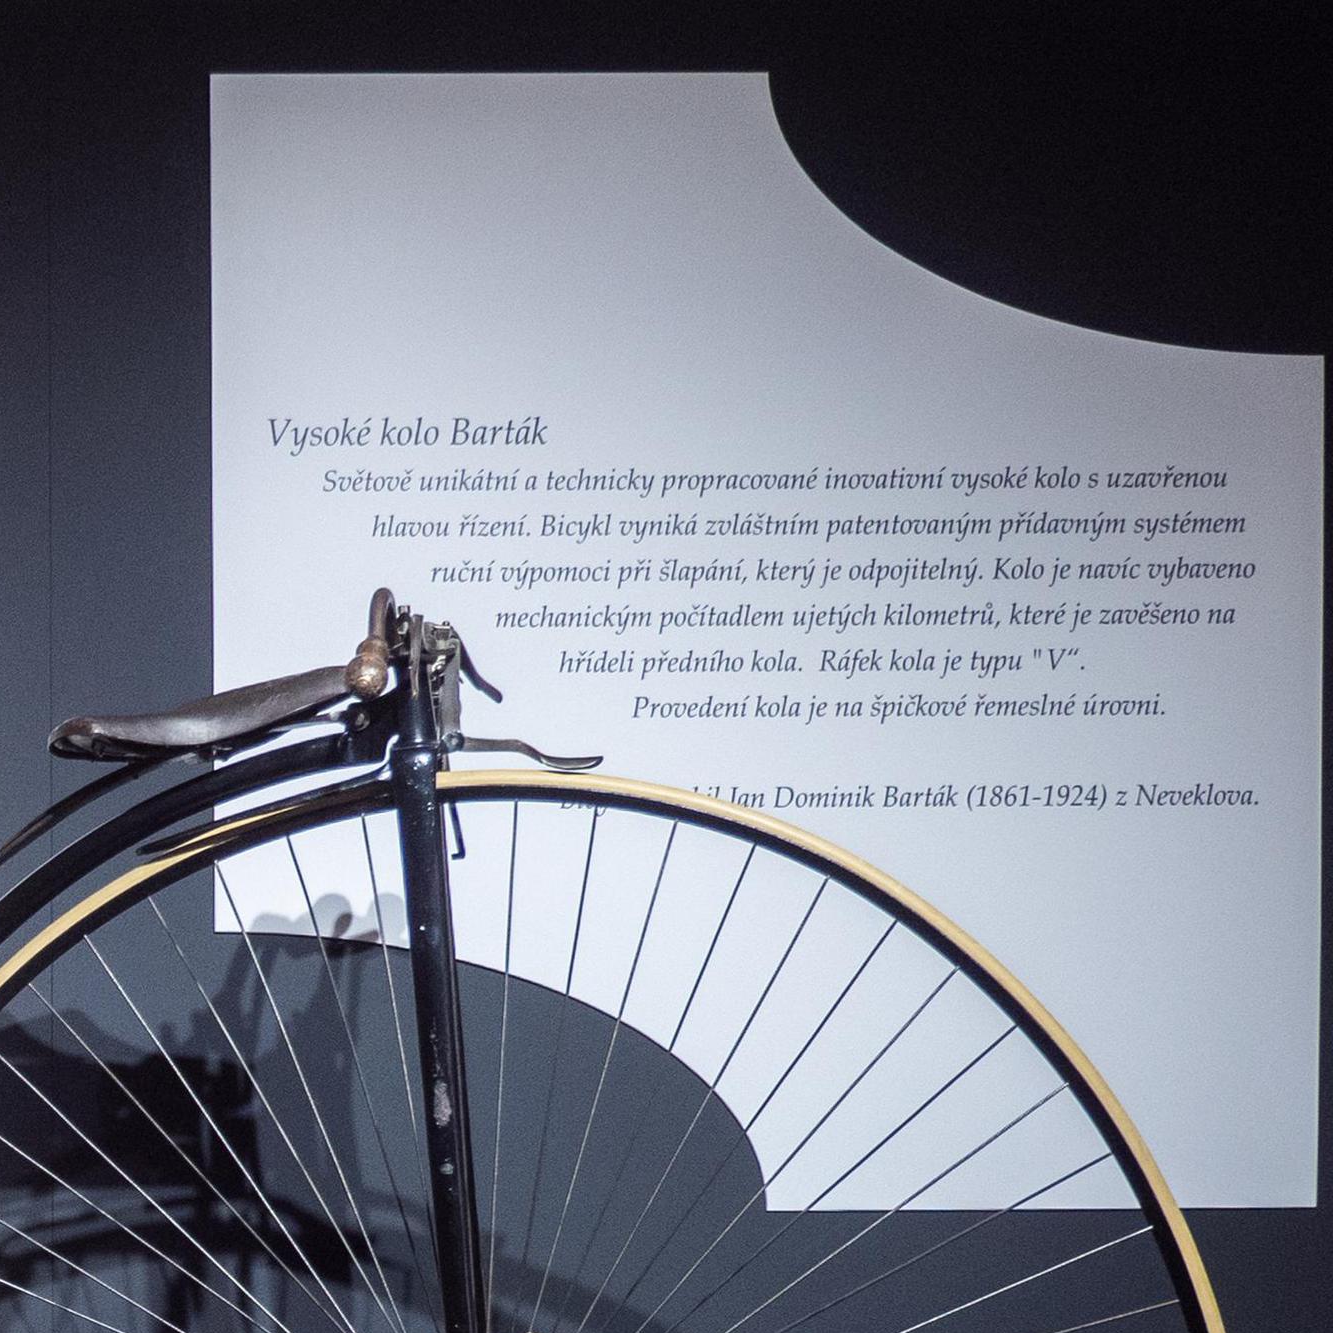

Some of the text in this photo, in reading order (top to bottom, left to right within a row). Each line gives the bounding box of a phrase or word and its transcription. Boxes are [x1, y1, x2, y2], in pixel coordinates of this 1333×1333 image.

[267, 415, 548, 457] Vysoké kolo Barták
[322, 464, 1227, 498] Světově unikátní a technicky propracované inovativní vysoké kolo s uzavřenou
[371, 510, 1245, 544] hlavou řízení. Bicykl vyniká zvláštním patentovaným přídavným systémem
[430, 555, 1256, 590] ruční výpomoci při šlapání, který je odpojitelný. Kolo je navíc vybaveno
[495, 601, 1235, 635] mechanickým počítadlem ujetých kilometrů, které je zavěšeno na
[558, 649, 634, 673] hřídeli
[640, 649, 744, 680] předního
[750, 648, 802, 672] kola.
[818, 647, 884, 679] Ráfek
[888, 647, 935, 672] kola
[938, 648, 962, 679] je
[970, 650, 1022, 679] typu
[631, 692, 1165, 725] Provedení kola je na špičkové řemeslné úrovni.
[729, 785, 766, 808] Jan
[773, 784, 875, 808] Dominik
[881, 783, 959, 808] Barták
[966, 783, 1107, 811] (1861-1924)
[1114, 790, 1128, 806] z
[1133, 782, 1259, 806] Neveklova.
